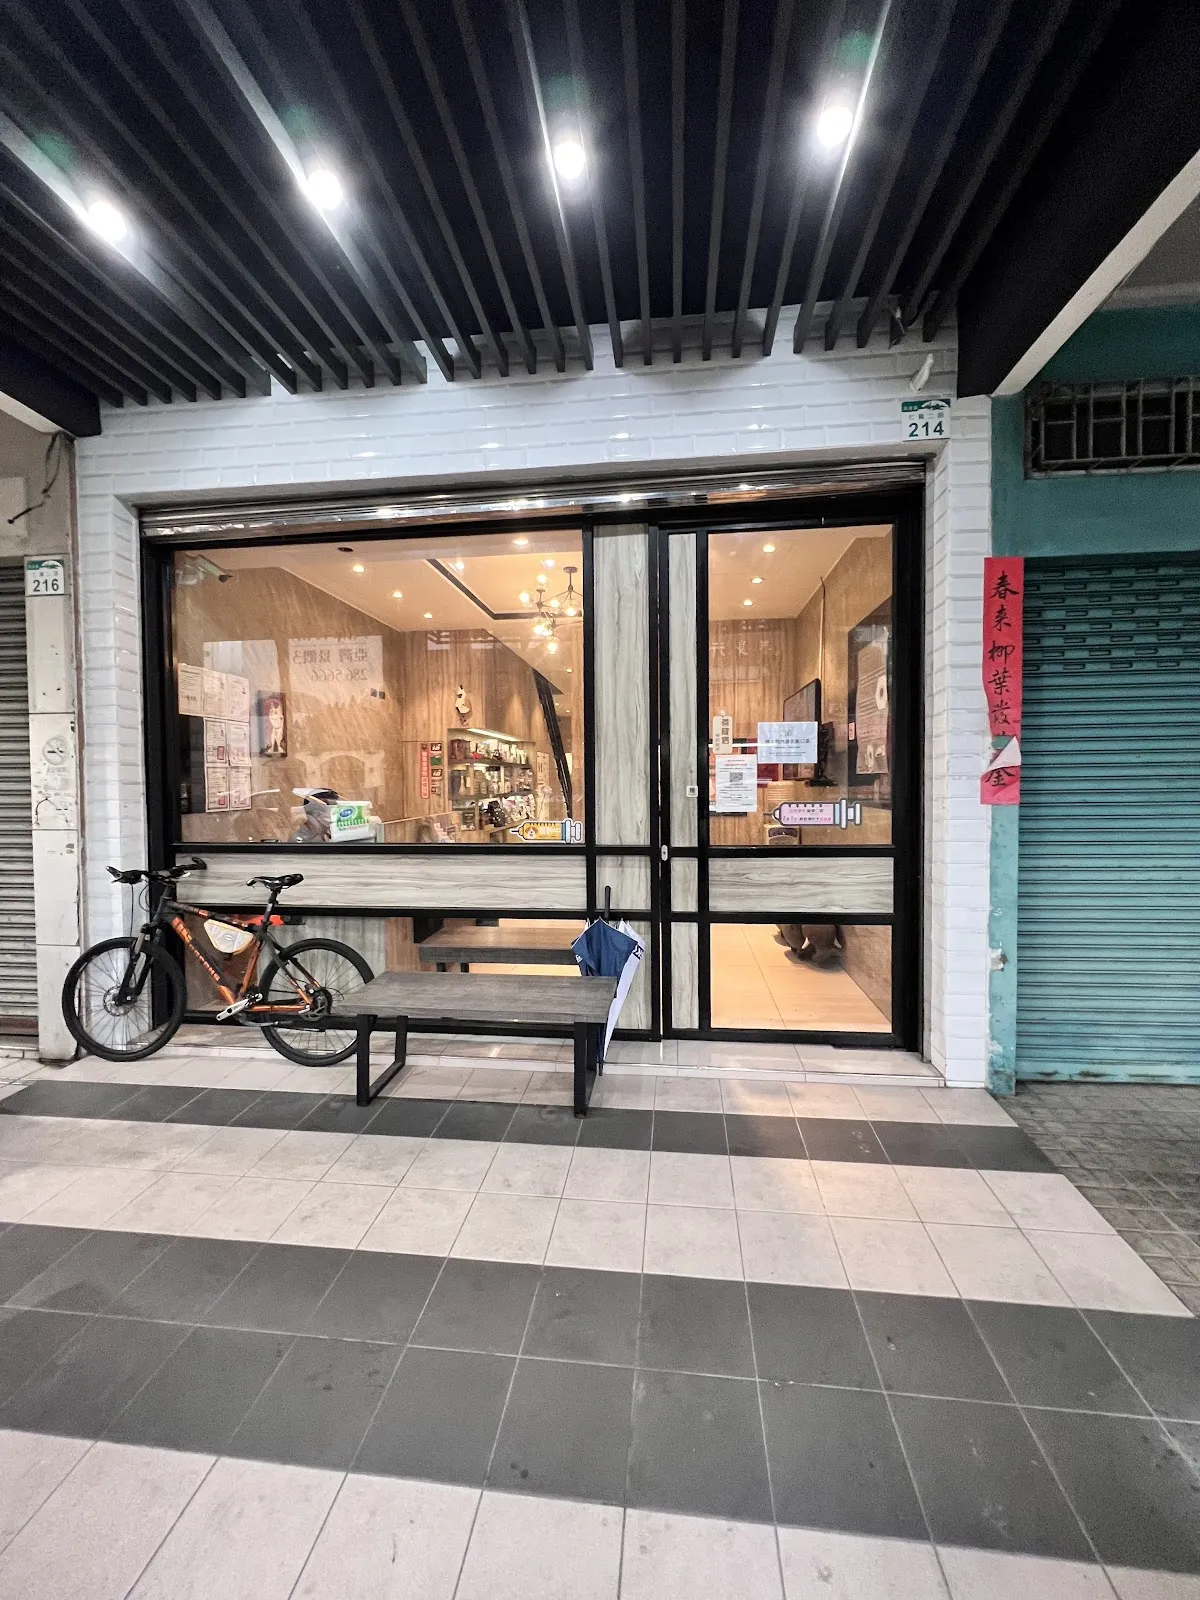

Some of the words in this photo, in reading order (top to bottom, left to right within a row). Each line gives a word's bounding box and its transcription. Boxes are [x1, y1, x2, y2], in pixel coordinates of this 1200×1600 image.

[908, 420, 944, 437] 214
[32, 578, 59, 592] 216
[986, 570, 1020, 787] 春來柳葉發金
